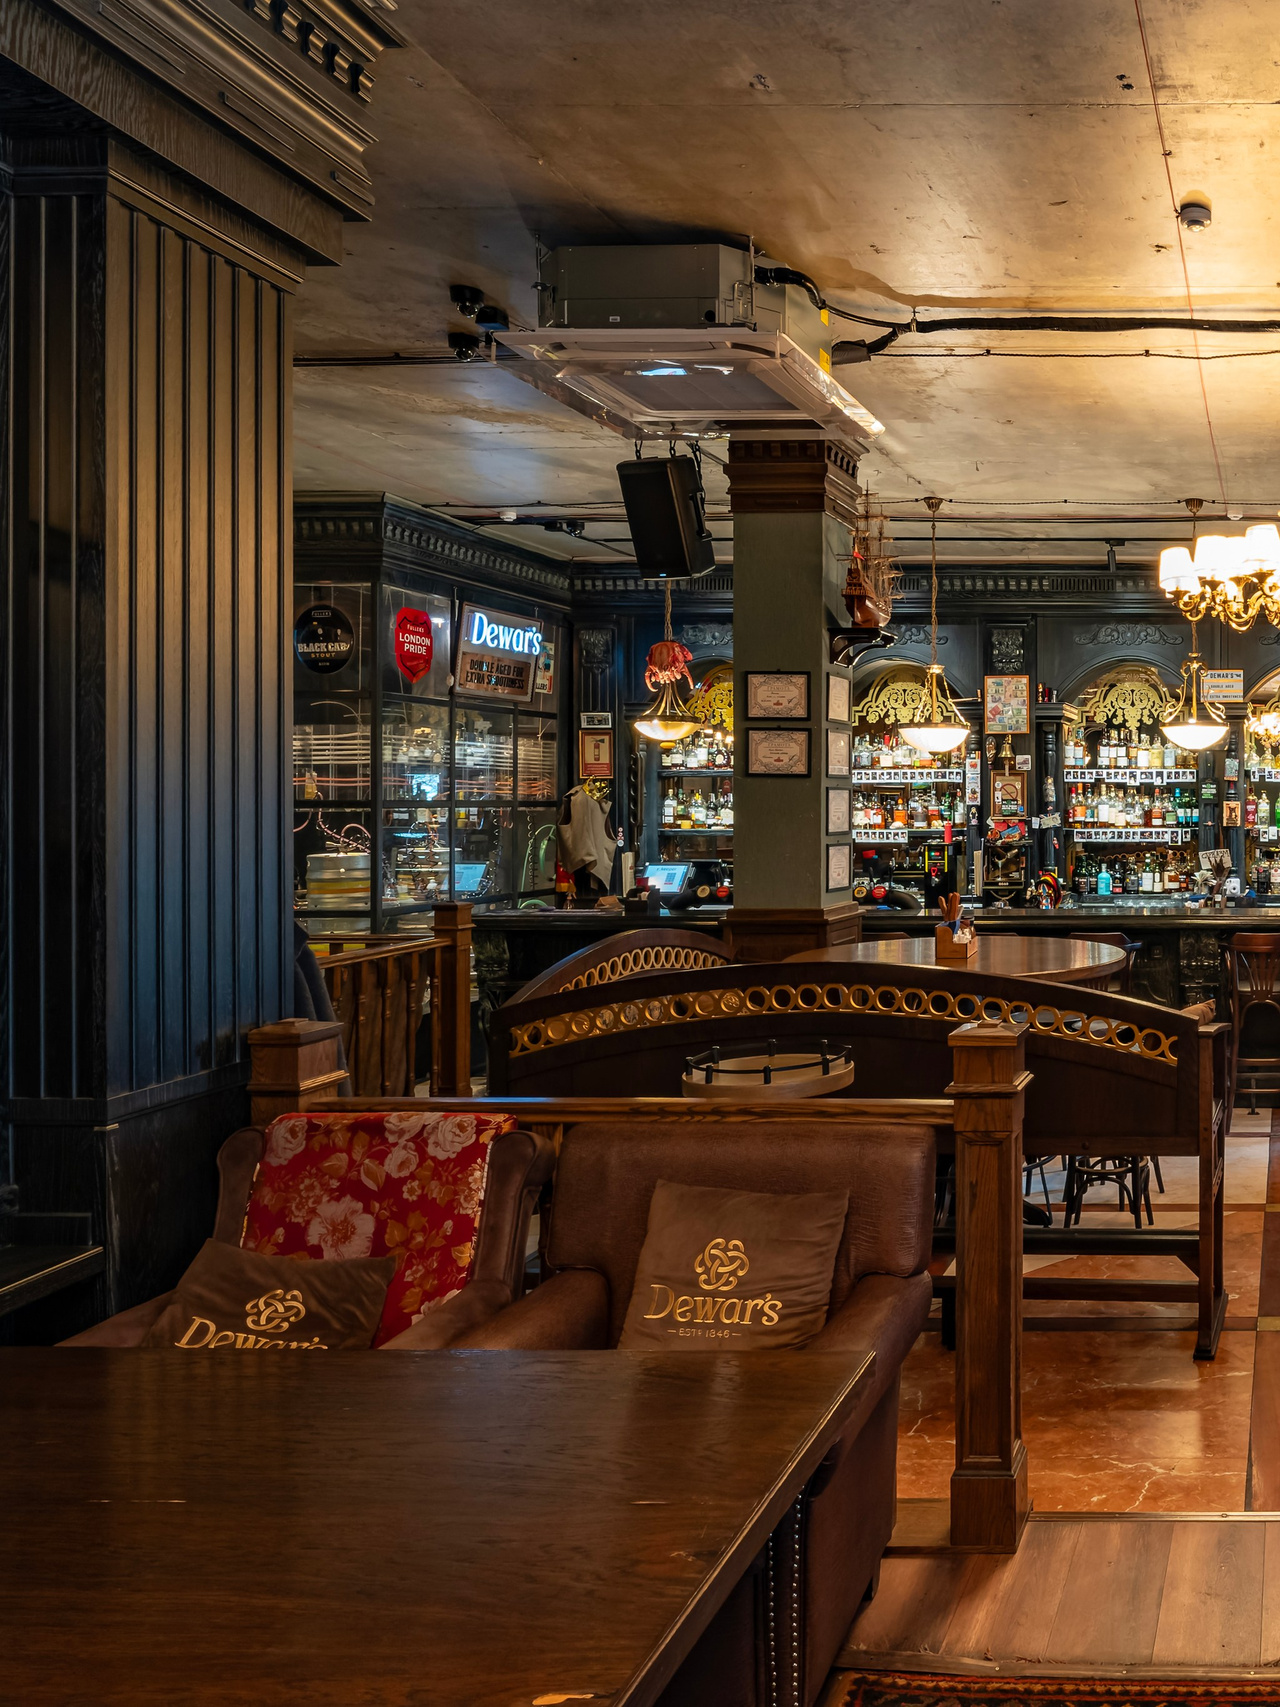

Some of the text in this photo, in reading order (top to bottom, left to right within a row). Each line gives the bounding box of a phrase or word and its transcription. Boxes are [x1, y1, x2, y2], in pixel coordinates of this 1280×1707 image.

[399, 632, 431, 647] LONDON
[471, 612, 542, 655] Dewar's
[297, 642, 349, 653] BLACK CAB
[404, 643, 427, 655] PRIDE
[643, 1284, 783, 1326] Dewar's
[174, 1316, 329, 1349] Dew'
[705, 1328, 731, 1338] 1846
